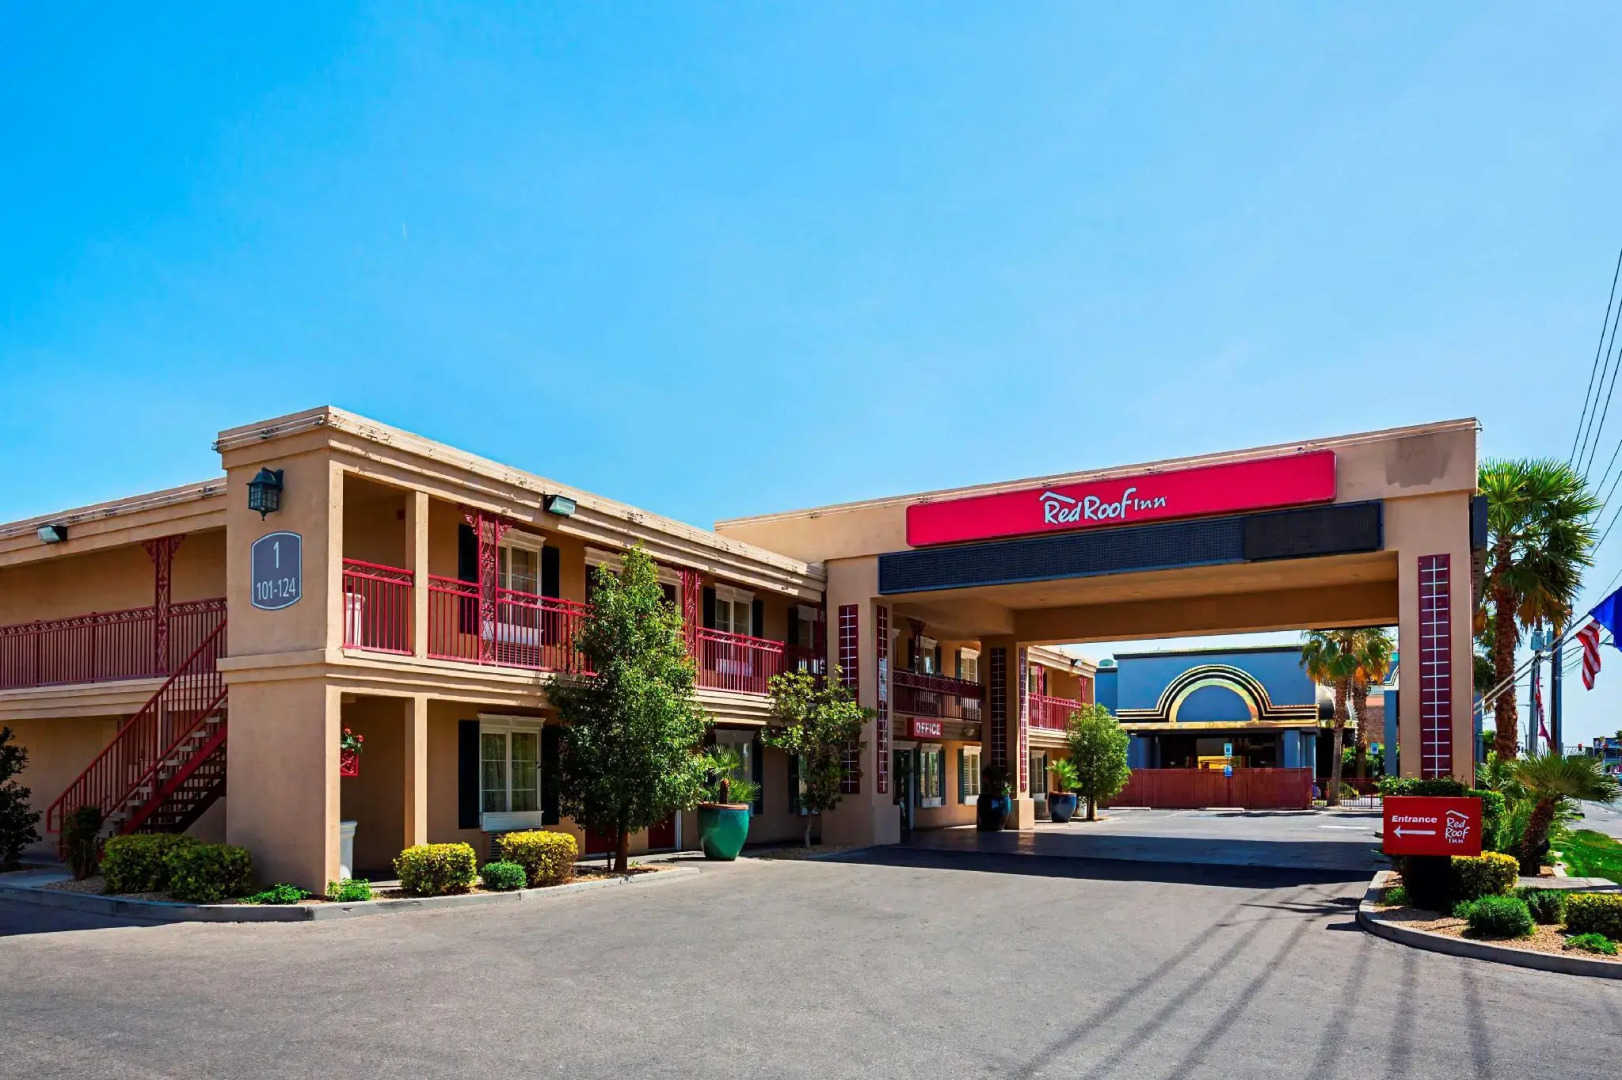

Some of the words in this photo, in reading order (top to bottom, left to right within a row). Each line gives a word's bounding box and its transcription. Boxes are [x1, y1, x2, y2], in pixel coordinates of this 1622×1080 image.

[1044, 500, 1083, 525] Red
[1084, 487, 1137, 521] Roof
[1134, 496, 1166, 511] Inn
[273, 541, 279, 569] 1
[256, 577, 296, 600] 101-124
[916, 721, 941, 736] OFFICE
[1391, 815, 1438, 824] Entrance
[1446, 817, 1466, 828] Red
[1444, 826, 1471, 840] Roof
